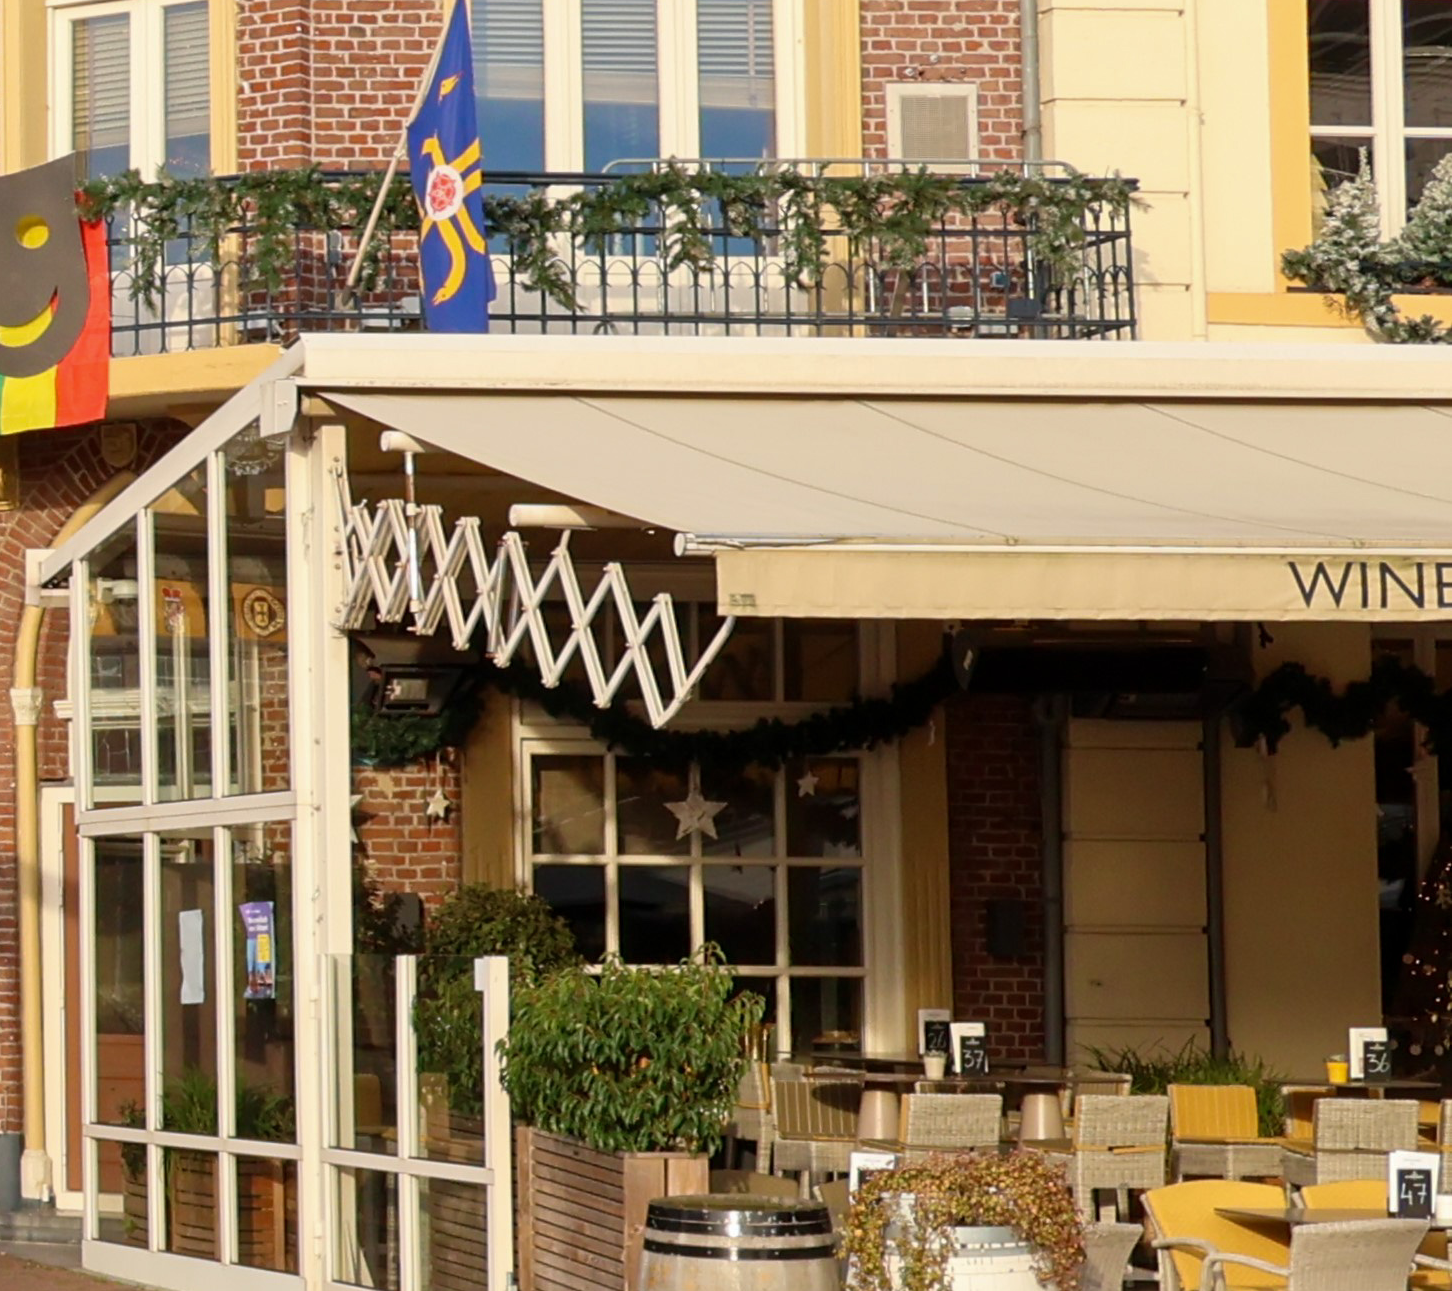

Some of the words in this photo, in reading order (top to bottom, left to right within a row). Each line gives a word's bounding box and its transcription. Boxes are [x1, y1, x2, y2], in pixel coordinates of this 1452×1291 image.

[963, 1049, 985, 1069] 37
[1366, 1052, 1390, 1073] 36
[1400, 1182, 1427, 1205] 47
